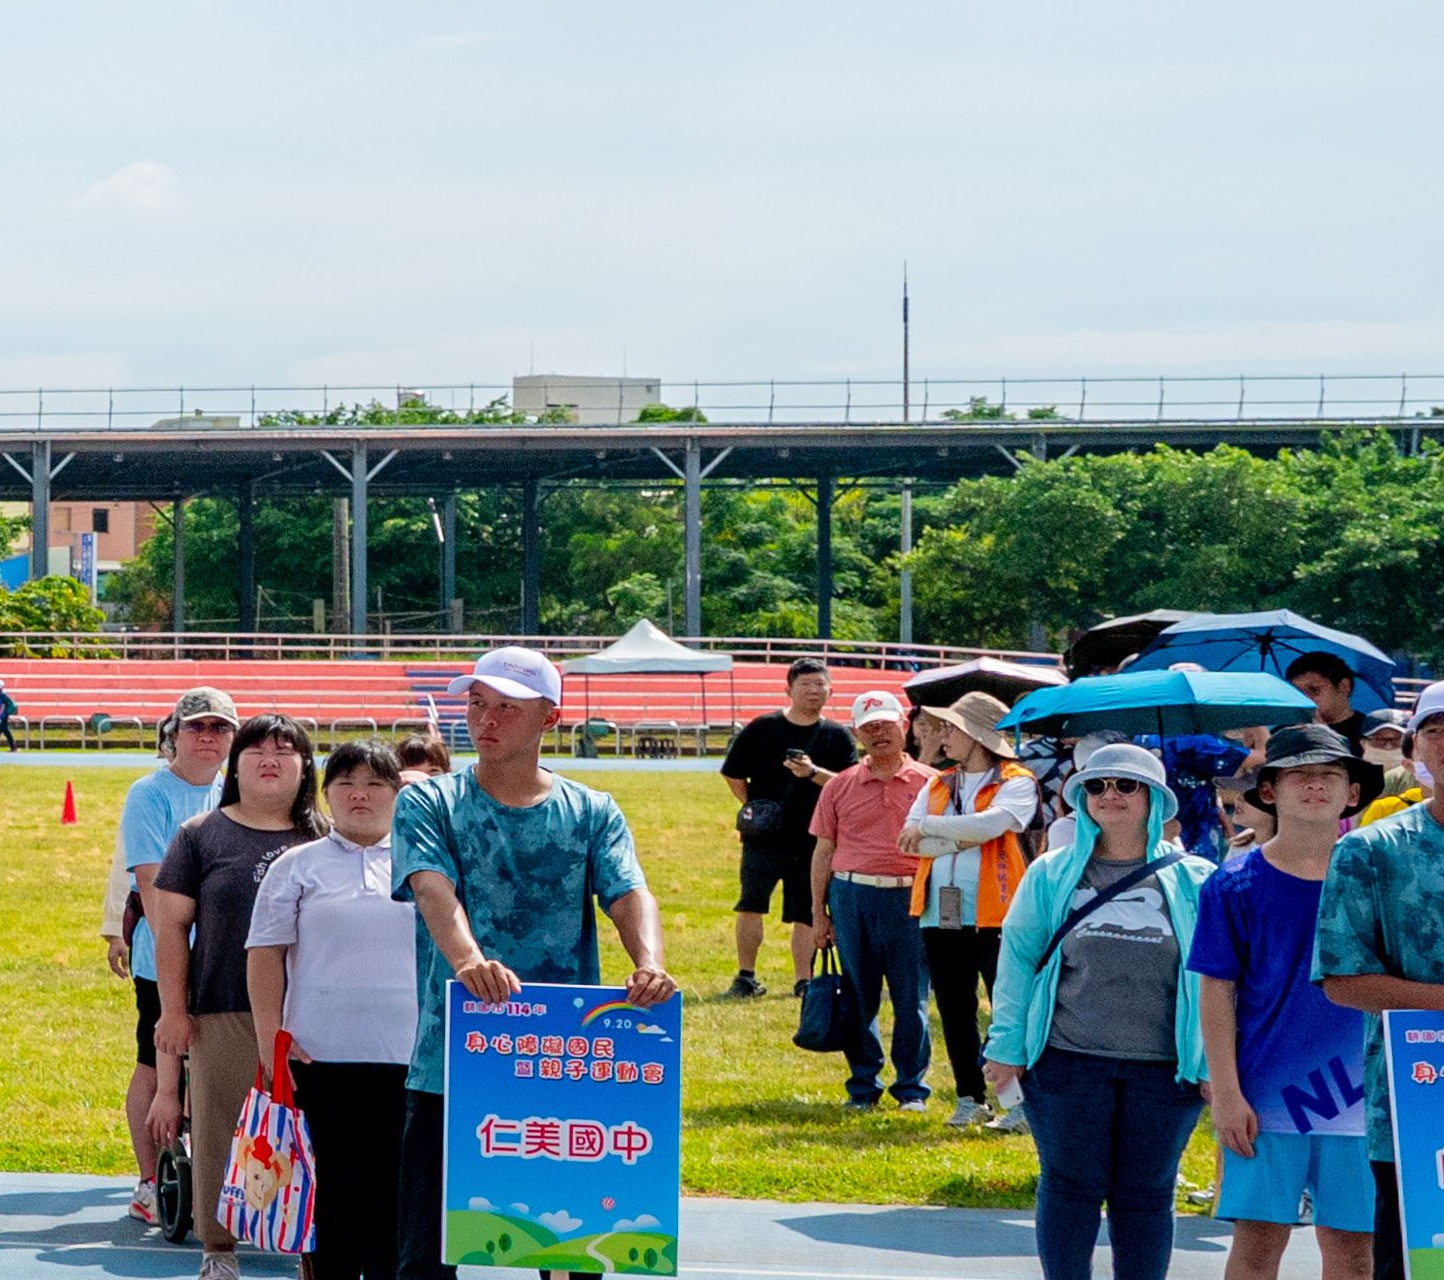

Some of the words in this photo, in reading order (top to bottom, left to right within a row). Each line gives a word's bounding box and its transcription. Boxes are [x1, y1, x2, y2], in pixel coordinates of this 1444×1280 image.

[603, 1018, 632, 1030] 9.20
[465, 1031, 615, 1058] 身心障礙國民
[514, 1059, 664, 1085] 暨親子運動會
[476, 1113, 652, 1166] 仁美國中
